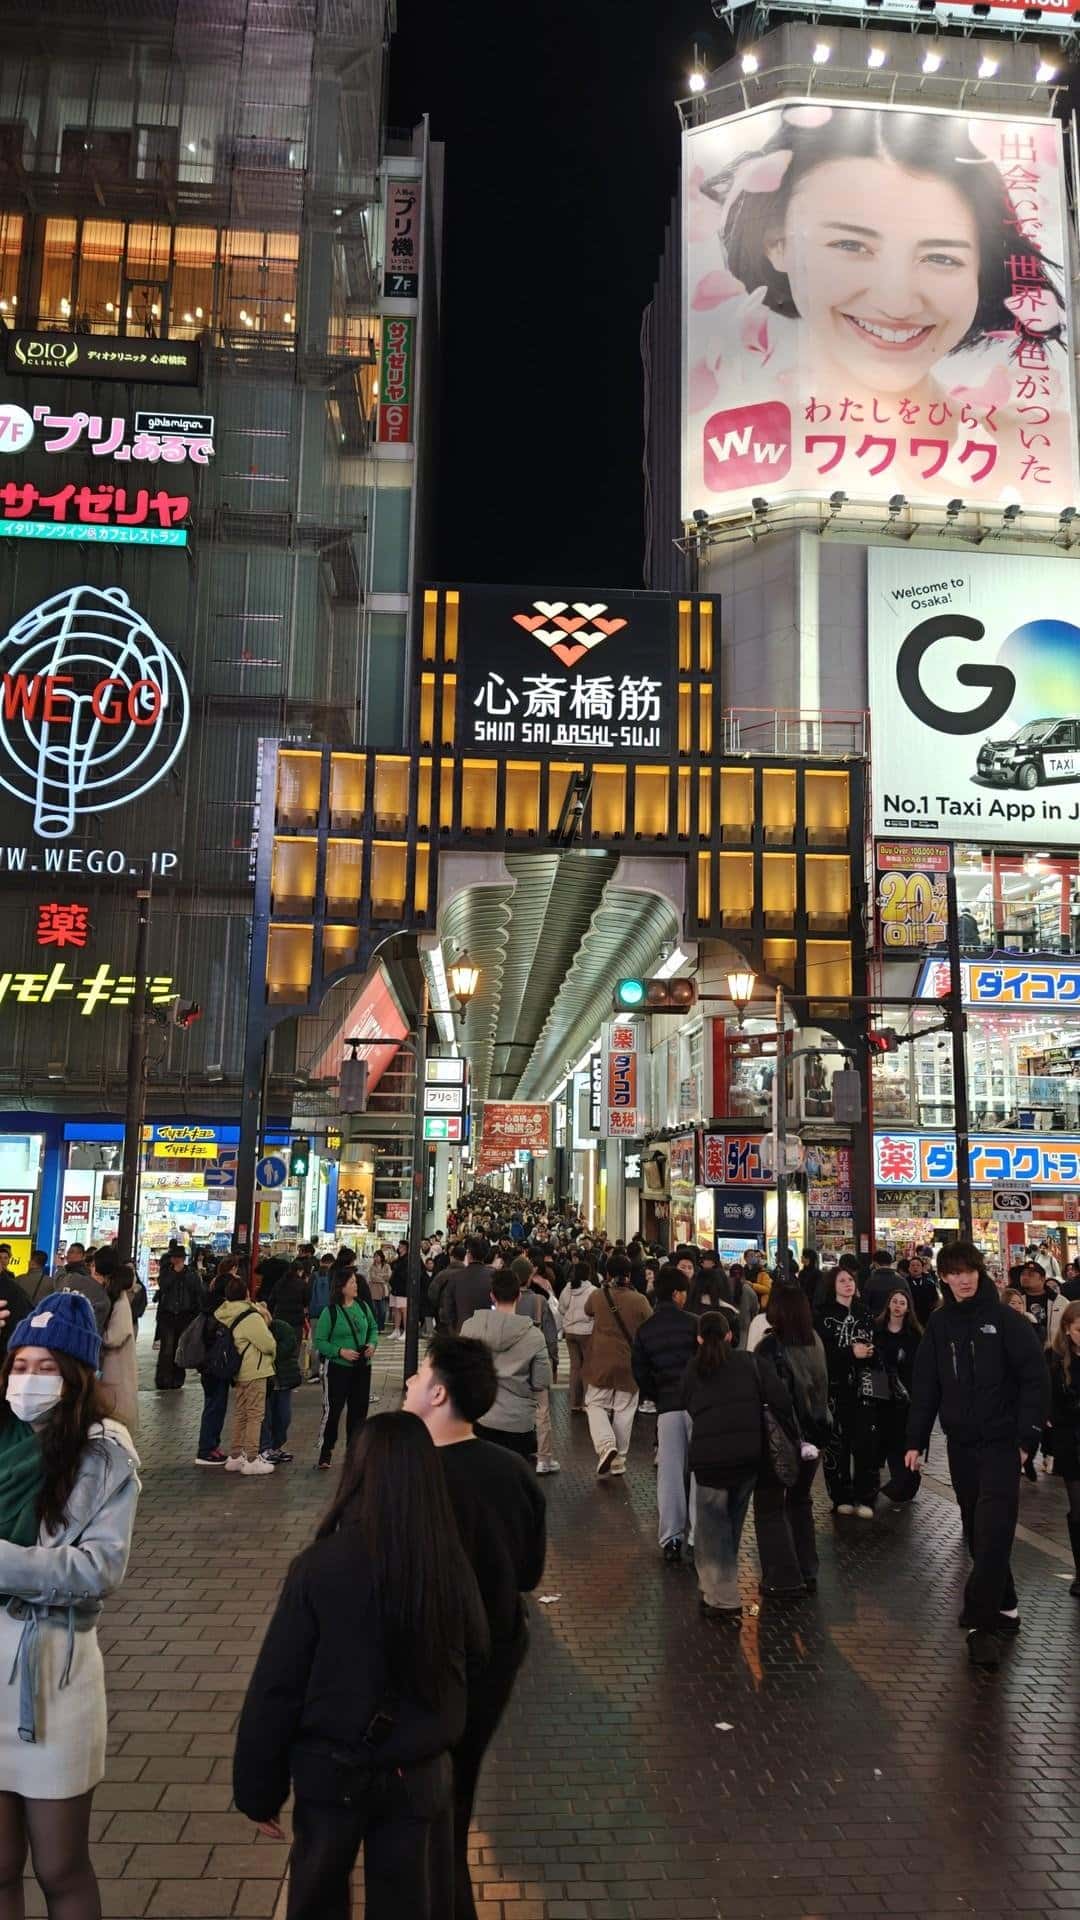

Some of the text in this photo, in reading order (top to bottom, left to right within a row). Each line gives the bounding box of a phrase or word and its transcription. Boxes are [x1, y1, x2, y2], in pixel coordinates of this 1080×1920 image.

[391, 197, 416, 257] プリ機
[392, 276, 412, 291] 7F
[27, 342, 67, 358] DIO
[27, 359, 65, 368] CLINIC
[387, 323, 407, 401] サイゼリヤ
[805, 396, 998, 431] わたしをひらく
[805, 434, 998, 483] ワクワク
[0, 483, 189, 527] サイゼリヤ
[892, 578, 964, 601] Welcome to
[911, 593, 952, 611] Osaka!
[473, 671, 663, 722] 心斎橋筋
[1050, 759, 1074, 770] TAXI
[884, 795, 928, 814] No.1
[936, 796, 981, 816] Taxi
[989, 799, 1035, 821] App
[1043, 801, 1061, 819] in
[880, 847, 892, 855] Buy
[893, 847, 908, 855] Over
[37, 904, 89, 947] 薬
[977, 968, 1080, 1000] ダイコク
[614, 1028, 632, 1048] 薬
[610, 1112, 635, 1127] 免税
[707, 1137, 724, 1180] 薬
[879, 1136, 915, 1181] 薬
